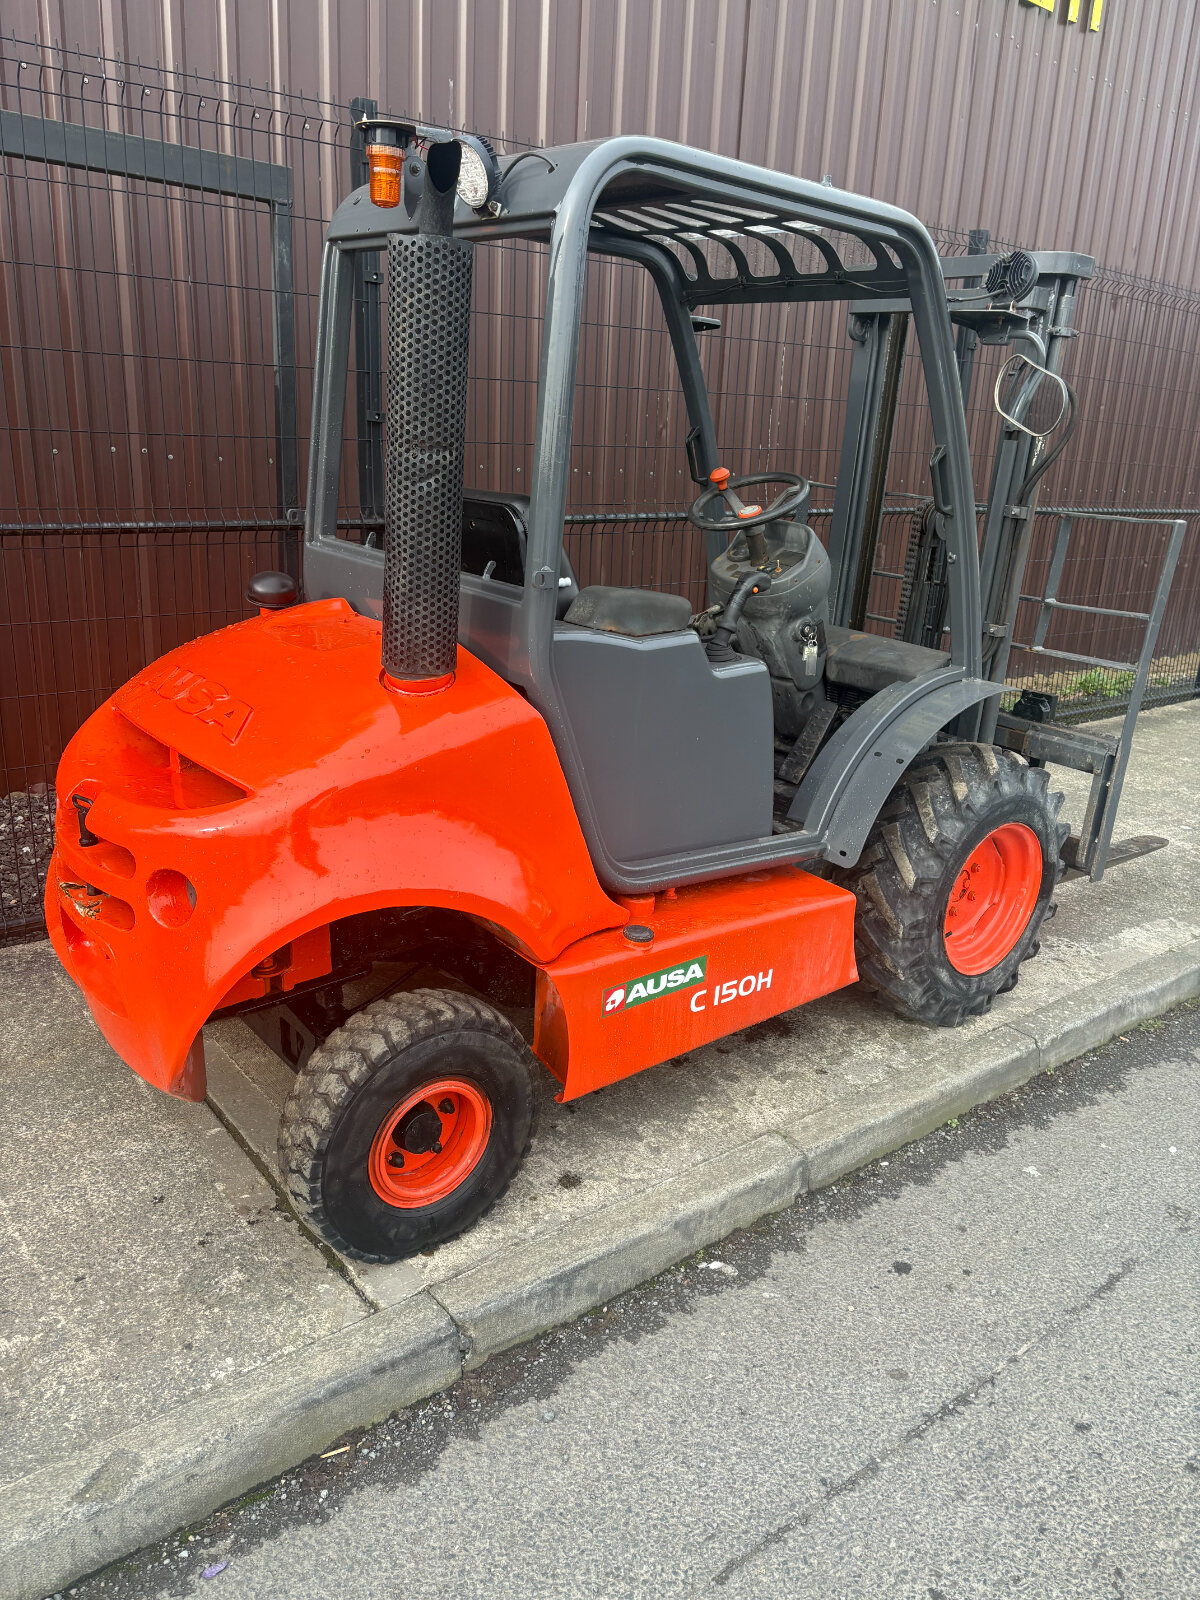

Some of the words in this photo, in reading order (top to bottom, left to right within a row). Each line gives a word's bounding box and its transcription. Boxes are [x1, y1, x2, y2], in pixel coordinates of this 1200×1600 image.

[626, 963, 704, 1004] AUSA
[690, 989, 708, 1013] C
[713, 968, 774, 1006] 150H
